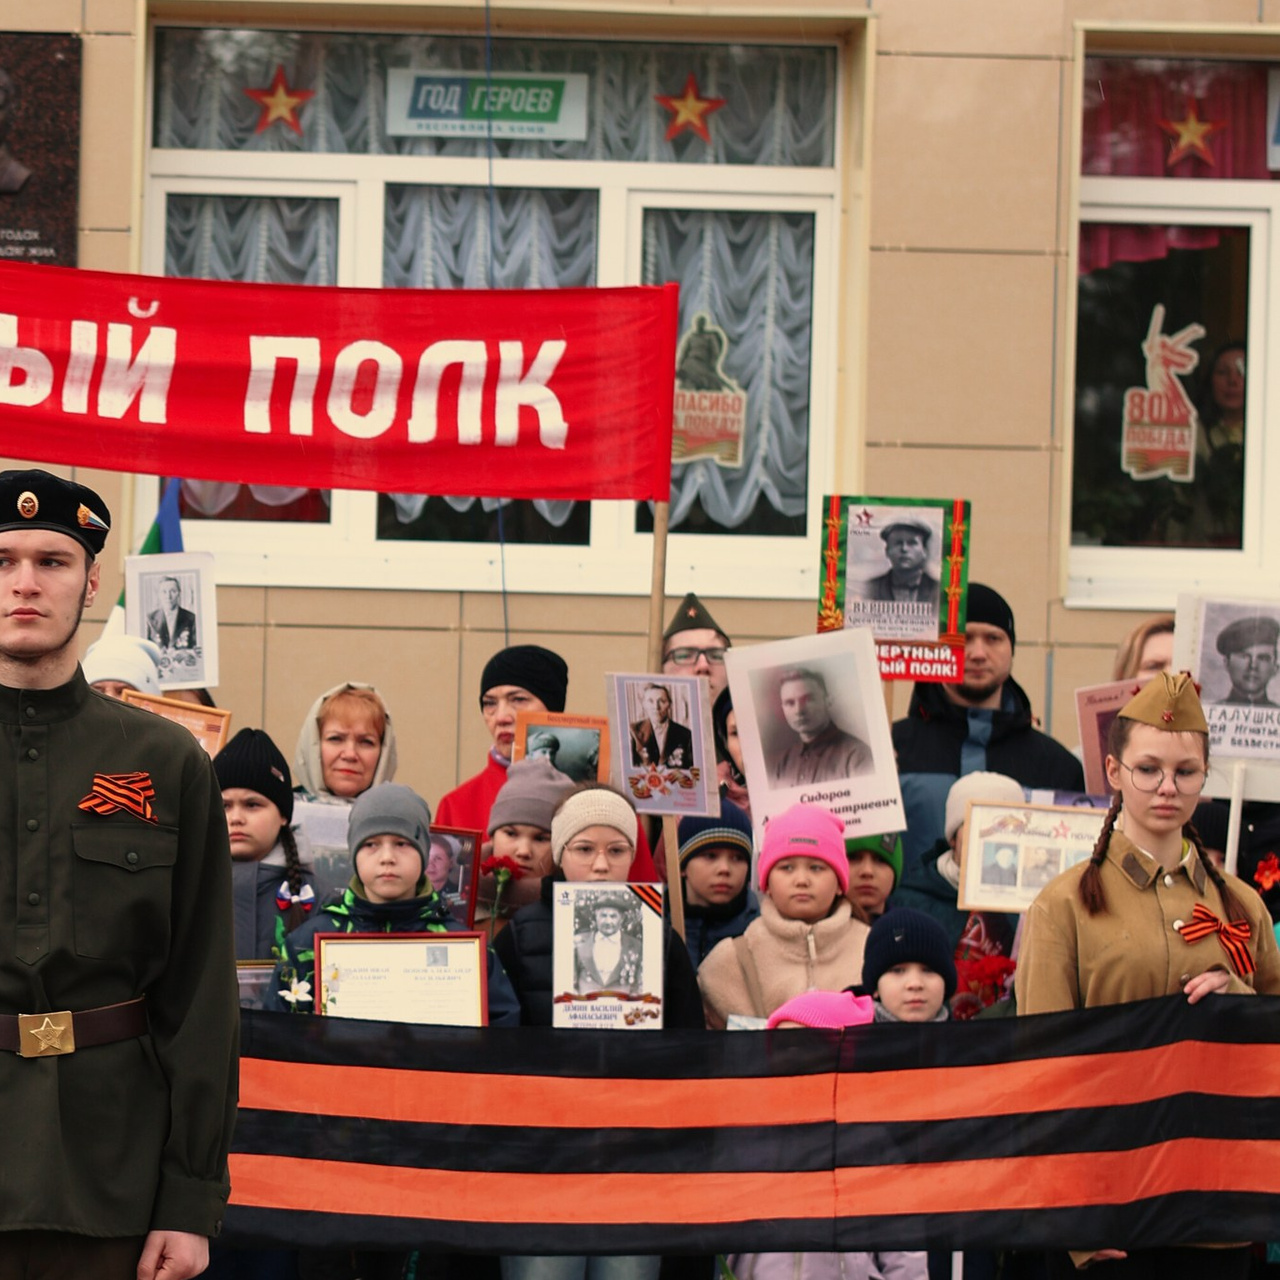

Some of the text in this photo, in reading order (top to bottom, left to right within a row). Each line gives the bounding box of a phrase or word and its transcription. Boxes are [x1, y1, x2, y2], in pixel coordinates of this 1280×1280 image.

[418, 84, 554, 114] ГОД ГЕРОЕВ
[0, 228, 40, 242] годах
[243, 334, 569, 451] ПОЛК
[674, 392, 743, 414] ПАСИБО
[1128, 391, 1169, 424] 80
[909, 661, 958, 678] ПОЛК!
[800, 789, 851, 805] Сидоров
[568, 1012, 618, 1021] АФАНАСЬЕВИЧ
[590, 1004, 623, 1012] ВАСИЛИЙ
